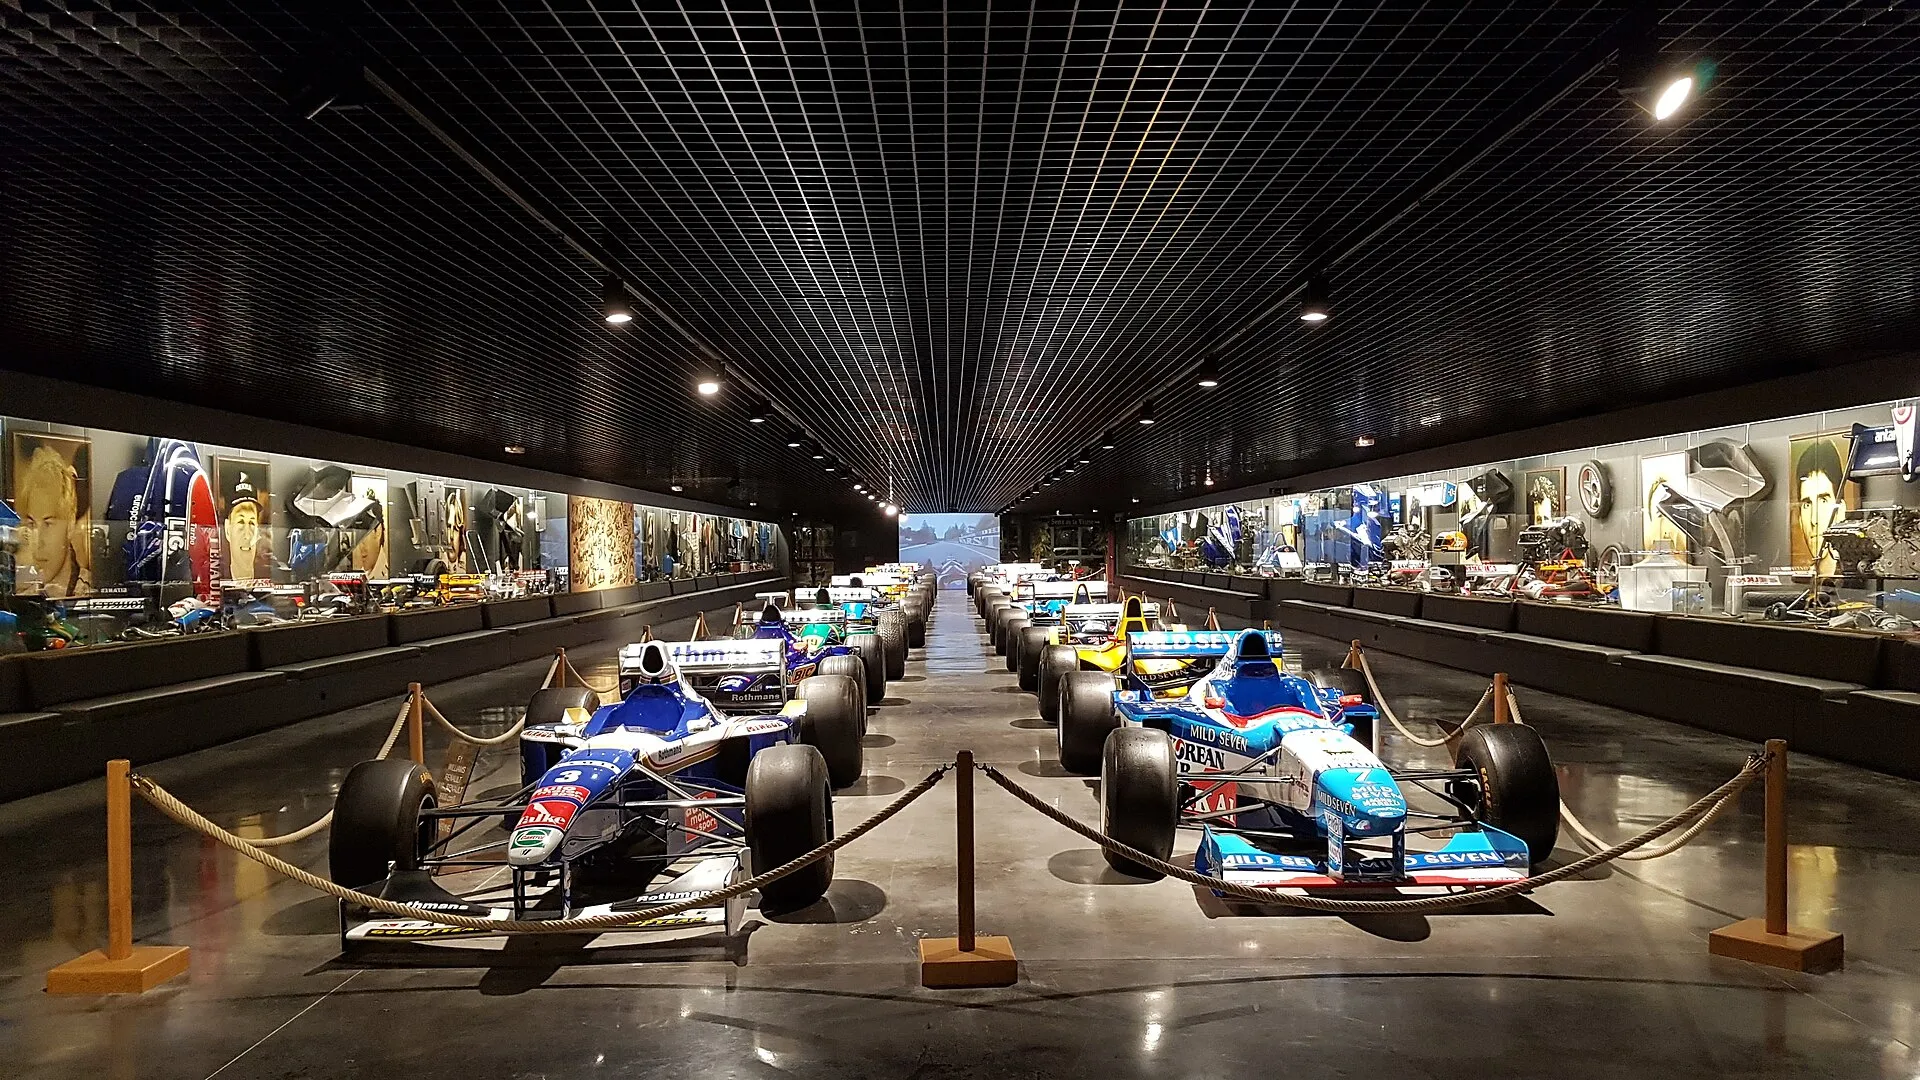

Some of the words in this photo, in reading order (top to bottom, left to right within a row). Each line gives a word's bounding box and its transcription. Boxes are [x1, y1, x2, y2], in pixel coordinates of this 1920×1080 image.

[1875, 429, 1896, 443] anta
[129, 494, 142, 533] europcar
[168, 519, 186, 555] LIG
[793, 667, 815, 684] BIC
[1158, 668, 1189, 680] SEVEN
[731, 693, 780, 702] Rothmans
[1190, 724, 1215, 742] MILD
[1219, 731, 1248, 752] SEVEN
[657, 744, 683, 761] Rothmans
[554, 770, 582, 783] 3
[1345, 769, 1373, 783] 7
[1351, 785, 1393, 793] MILD
[1317, 789, 1332, 807] MILD
[1332, 797, 1357, 817] SEVEN
[1352, 792, 1403, 801] SEVEN
[1223, 855, 1274, 865] MILD
[1424, 852, 1502, 864] SEVEN
[396, 900, 469, 911] thmans
